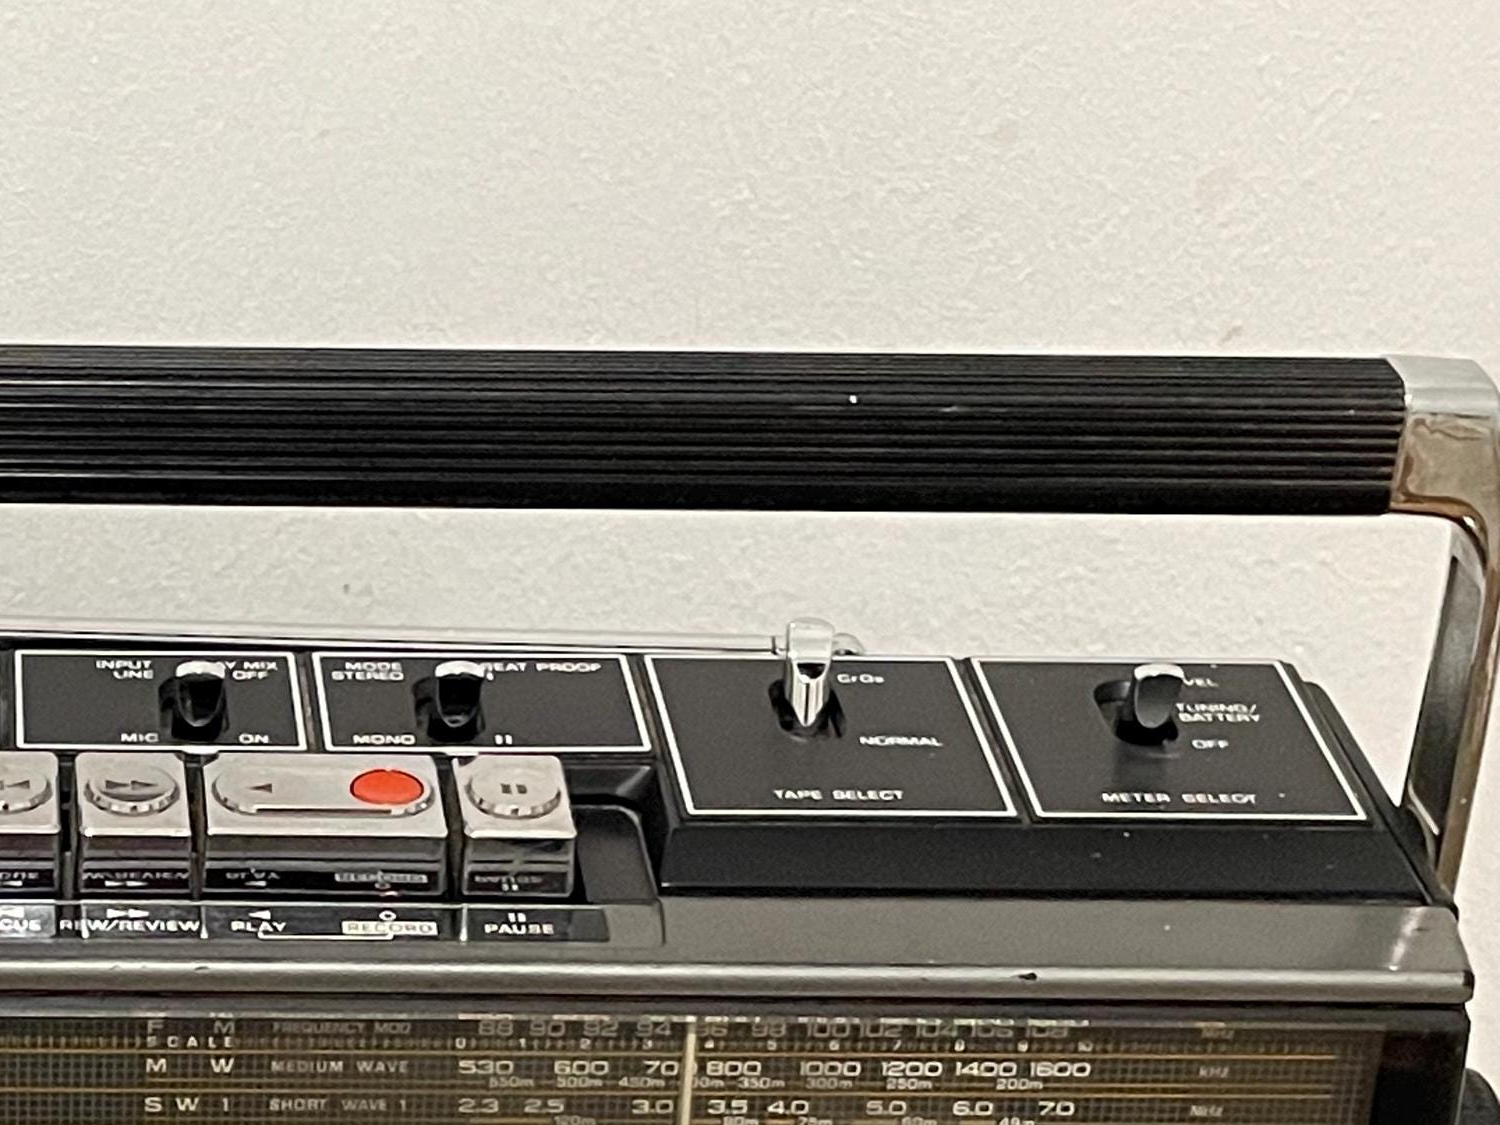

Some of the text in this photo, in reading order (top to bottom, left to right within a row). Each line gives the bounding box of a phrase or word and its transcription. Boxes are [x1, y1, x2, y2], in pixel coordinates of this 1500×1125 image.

[95, 660, 152, 669] INPUT
[243, 661, 279, 671] MIX
[345, 662, 402, 671] MODE
[535, 662, 601, 672] PROOF
[113, 670, 154, 679] LINE
[232, 670, 268, 680] OFF
[331, 671, 404, 681] STEREO
[1178, 713, 1260, 722] BATTERY
[120, 733, 159, 743] MIC
[238, 733, 270, 744] ON
[352, 735, 416, 745] MONO
[859, 735, 943, 747] NORMAL
[1192, 739, 1229, 749] OFF
[773, 789, 904, 800] TAPE SELECT
[1101, 792, 1257, 804] METER SELECT
[231, 921, 287, 933] PLAY
[347, 923, 432, 934] RECORD
[484, 923, 555, 935] PAUSE
[272, 1022, 365, 1034] FREQUENCY
[374, 1022, 412, 1034] MOD
[478, 1019, 514, 1037] 88
[529, 1019, 565, 1037] 90
[583, 1018, 619, 1037] 92
[636, 1018, 672, 1037] 94
[807, 1020, 851, 1037] 100
[859, 1022, 903, 1038] 102
[271, 1061, 344, 1073] MEDIUM
[356, 1061, 409, 1073] WAVE
[458, 1060, 514, 1075] 530
[554, 1060, 610, 1075] 600
[706, 1061, 762, 1076] 800
[800, 1061, 861, 1077] 1000
[881, 1061, 943, 1077] 1200
[955, 1061, 1018, 1077] 1400
[1029, 1062, 1091, 1077] 1600
[618, 1077, 666, 1088] 450m
[737, 1077, 786, 1089] 350m
[806, 1078, 853, 1089] 300m
[886, 1078, 933, 1090] 250m
[996, 1078, 1044, 1090] 200m
[269, 1098, 327, 1112] SHORT
[341, 1099, 388, 1111] WAVE
[458, 1098, 499, 1113] 2.3
[524, 1098, 565, 1113] 2.5
[632, 1099, 674, 1114] 3.0
[707, 1100, 748, 1115] 3.5
[767, 1100, 809, 1115] 4.0
[866, 1100, 907, 1115] 5.0
[952, 1101, 994, 1116] 6.0
[1038, 1101, 1075, 1116] 7.0
